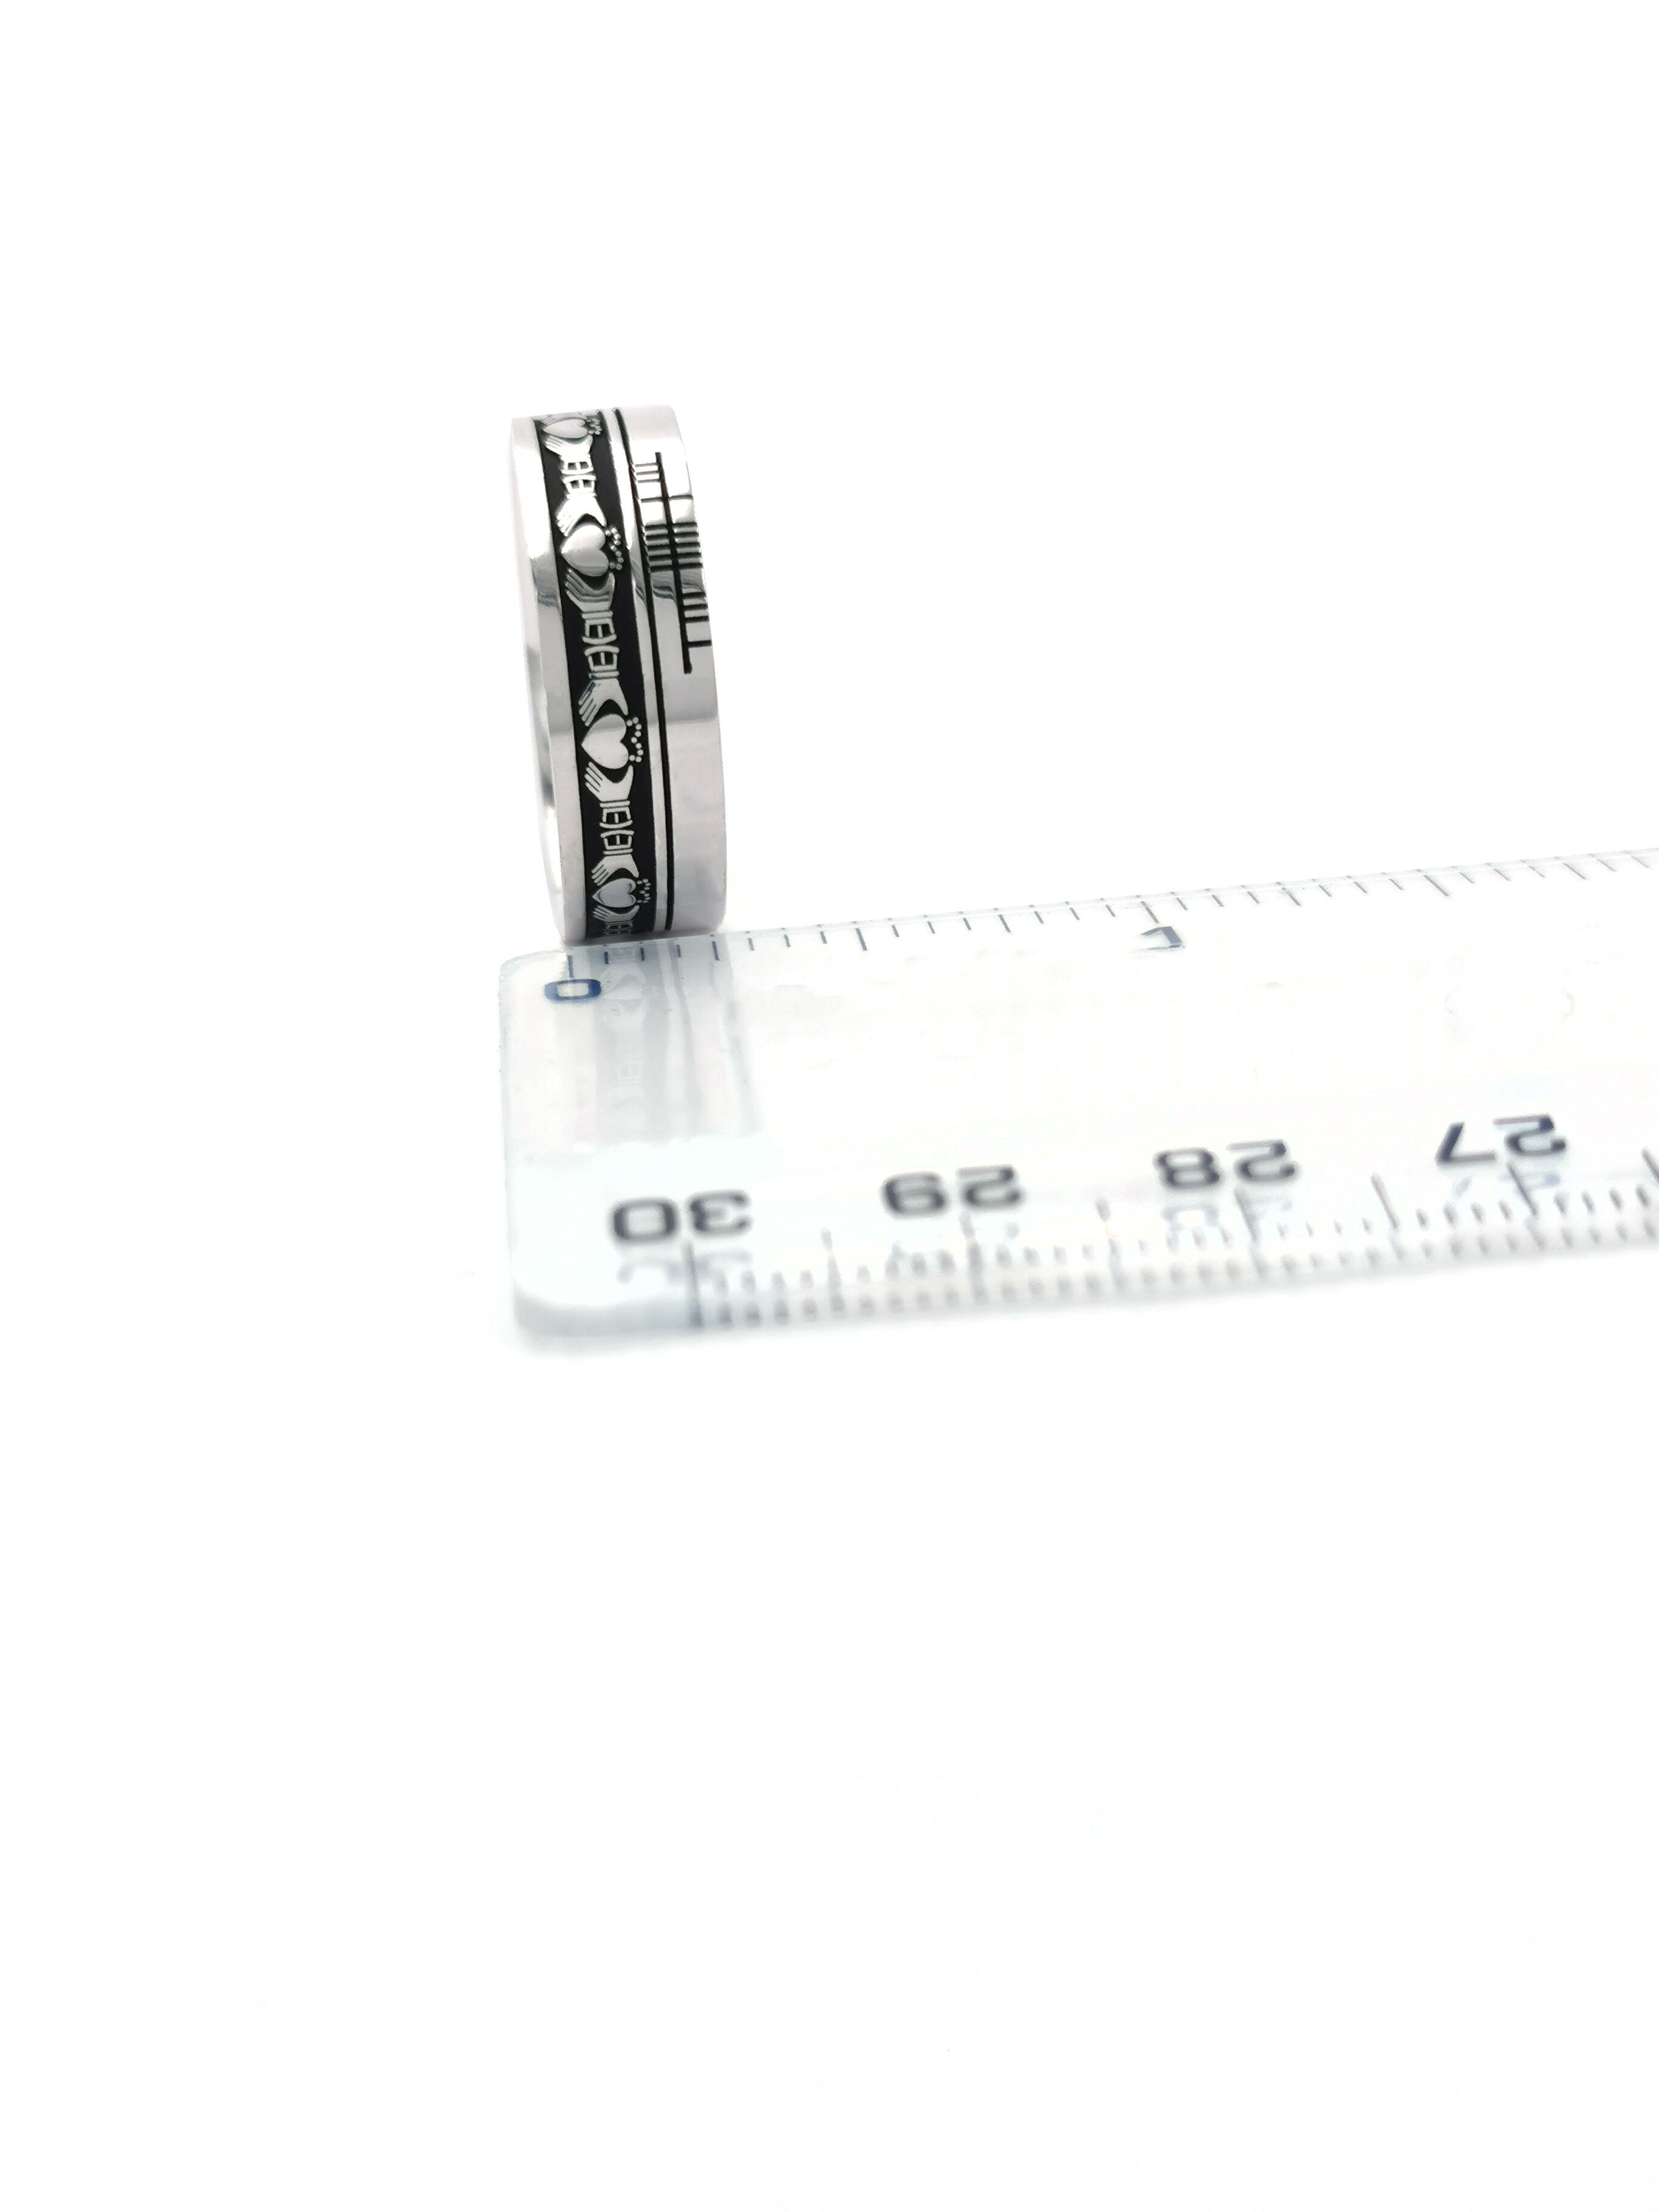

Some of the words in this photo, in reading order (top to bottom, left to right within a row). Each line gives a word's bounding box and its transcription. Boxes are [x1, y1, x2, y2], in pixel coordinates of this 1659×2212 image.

[545, 977, 602, 1001] 0
[1153, 1139, 1298, 1189] 28
[1435, 1114, 1568, 1165] 27
[610, 1188, 754, 1242] 30
[880, 1163, 1026, 1217] 29
